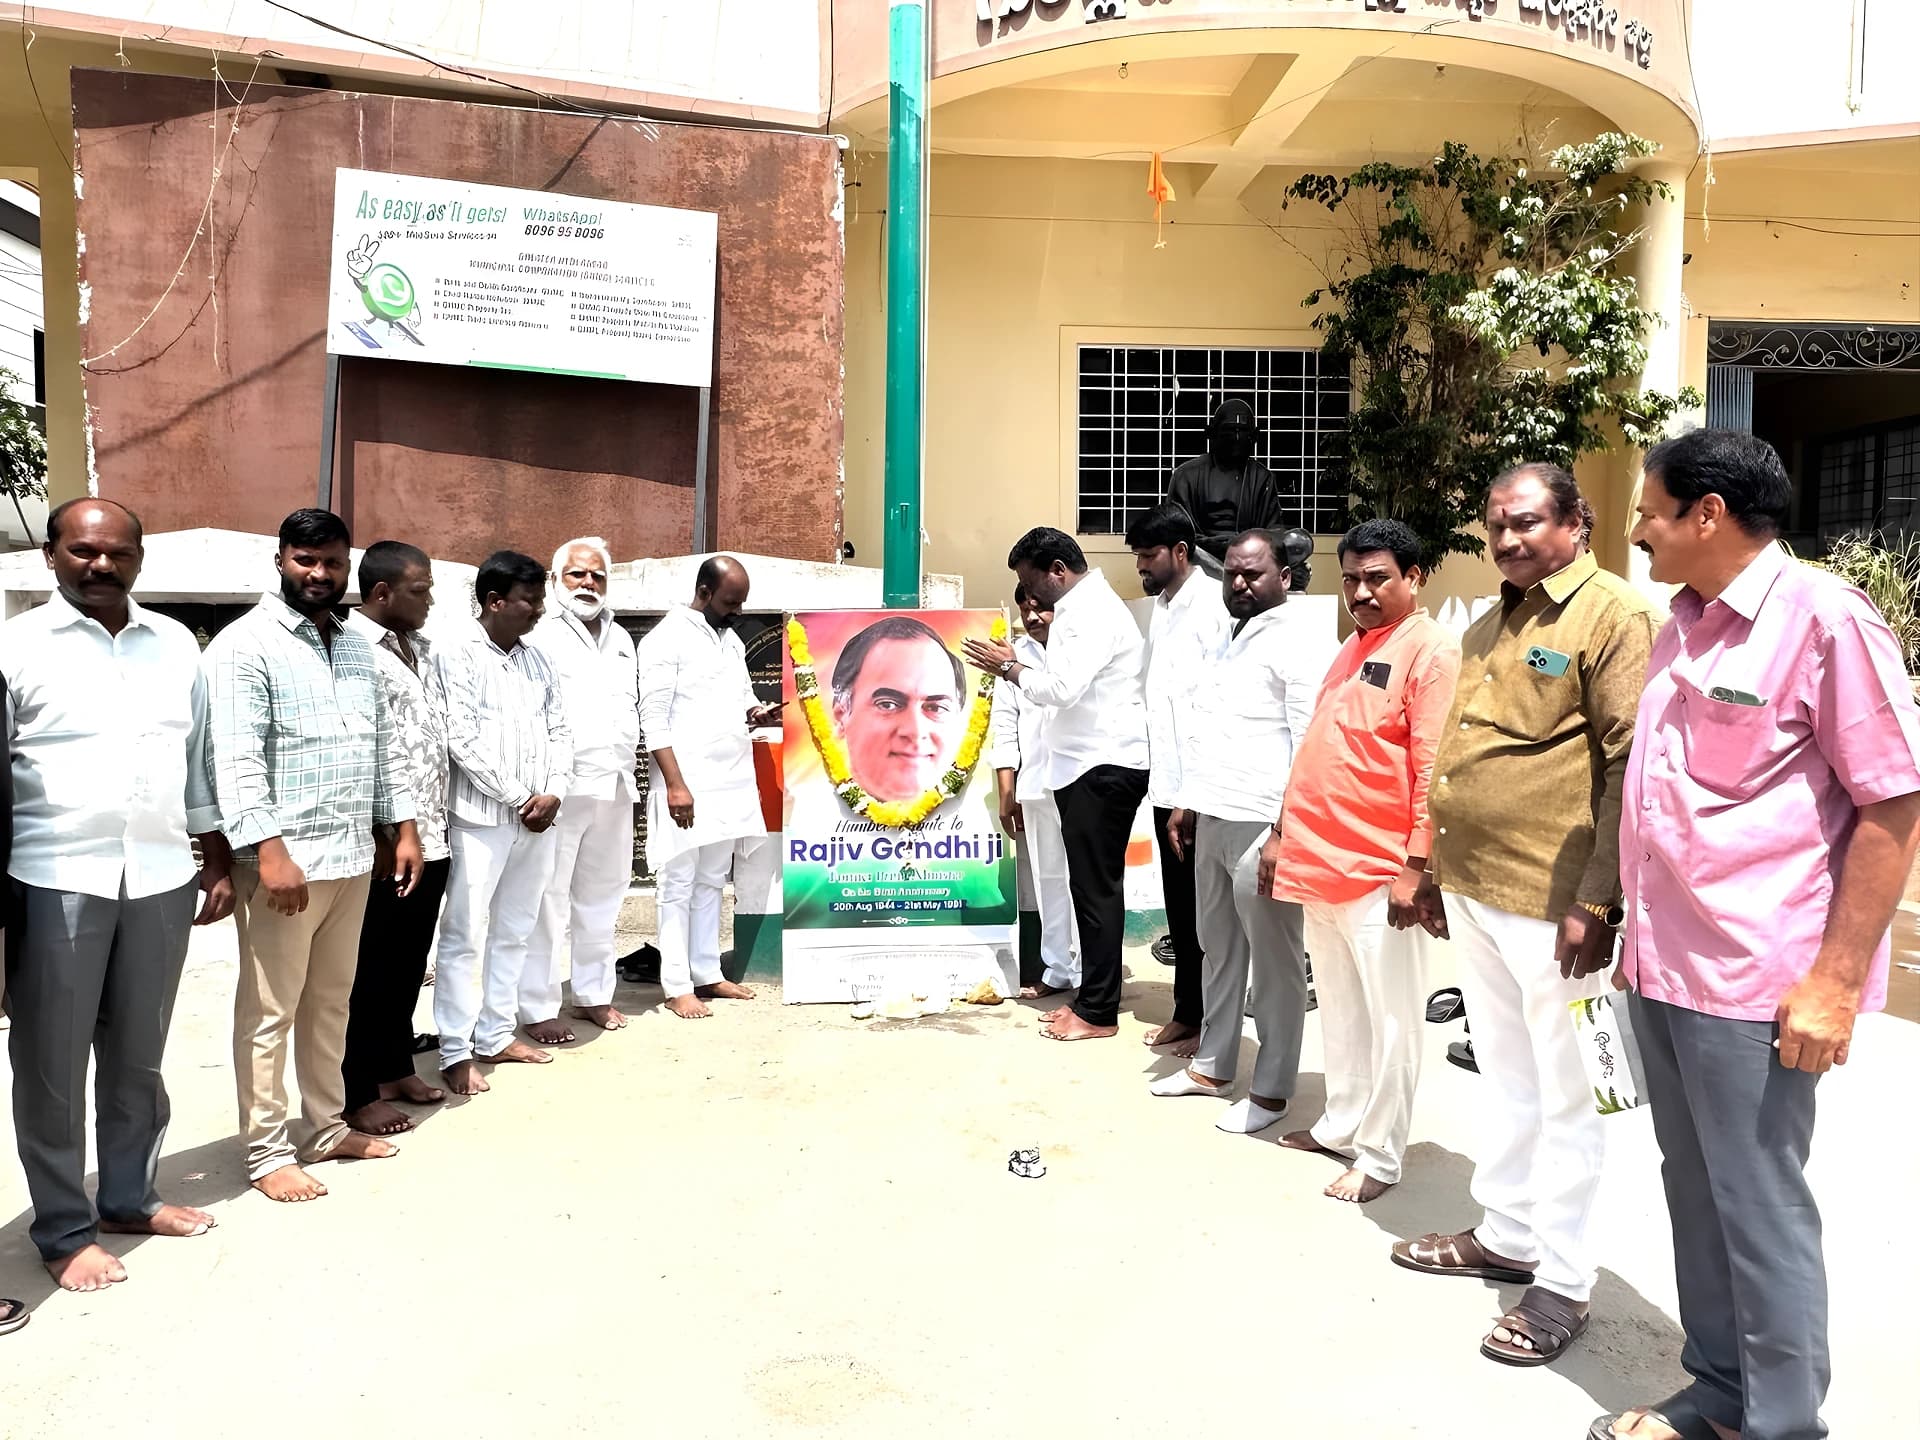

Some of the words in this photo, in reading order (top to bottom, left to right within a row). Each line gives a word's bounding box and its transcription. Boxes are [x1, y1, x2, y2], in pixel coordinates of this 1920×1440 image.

[356, 190, 379, 219] As
[384, 199, 423, 224] easy
[426, 202, 448, 222] as
[789, 836, 864, 868] Rajiv
[985, 832, 1003, 865] ji
[855, 901, 873, 912] Aug
